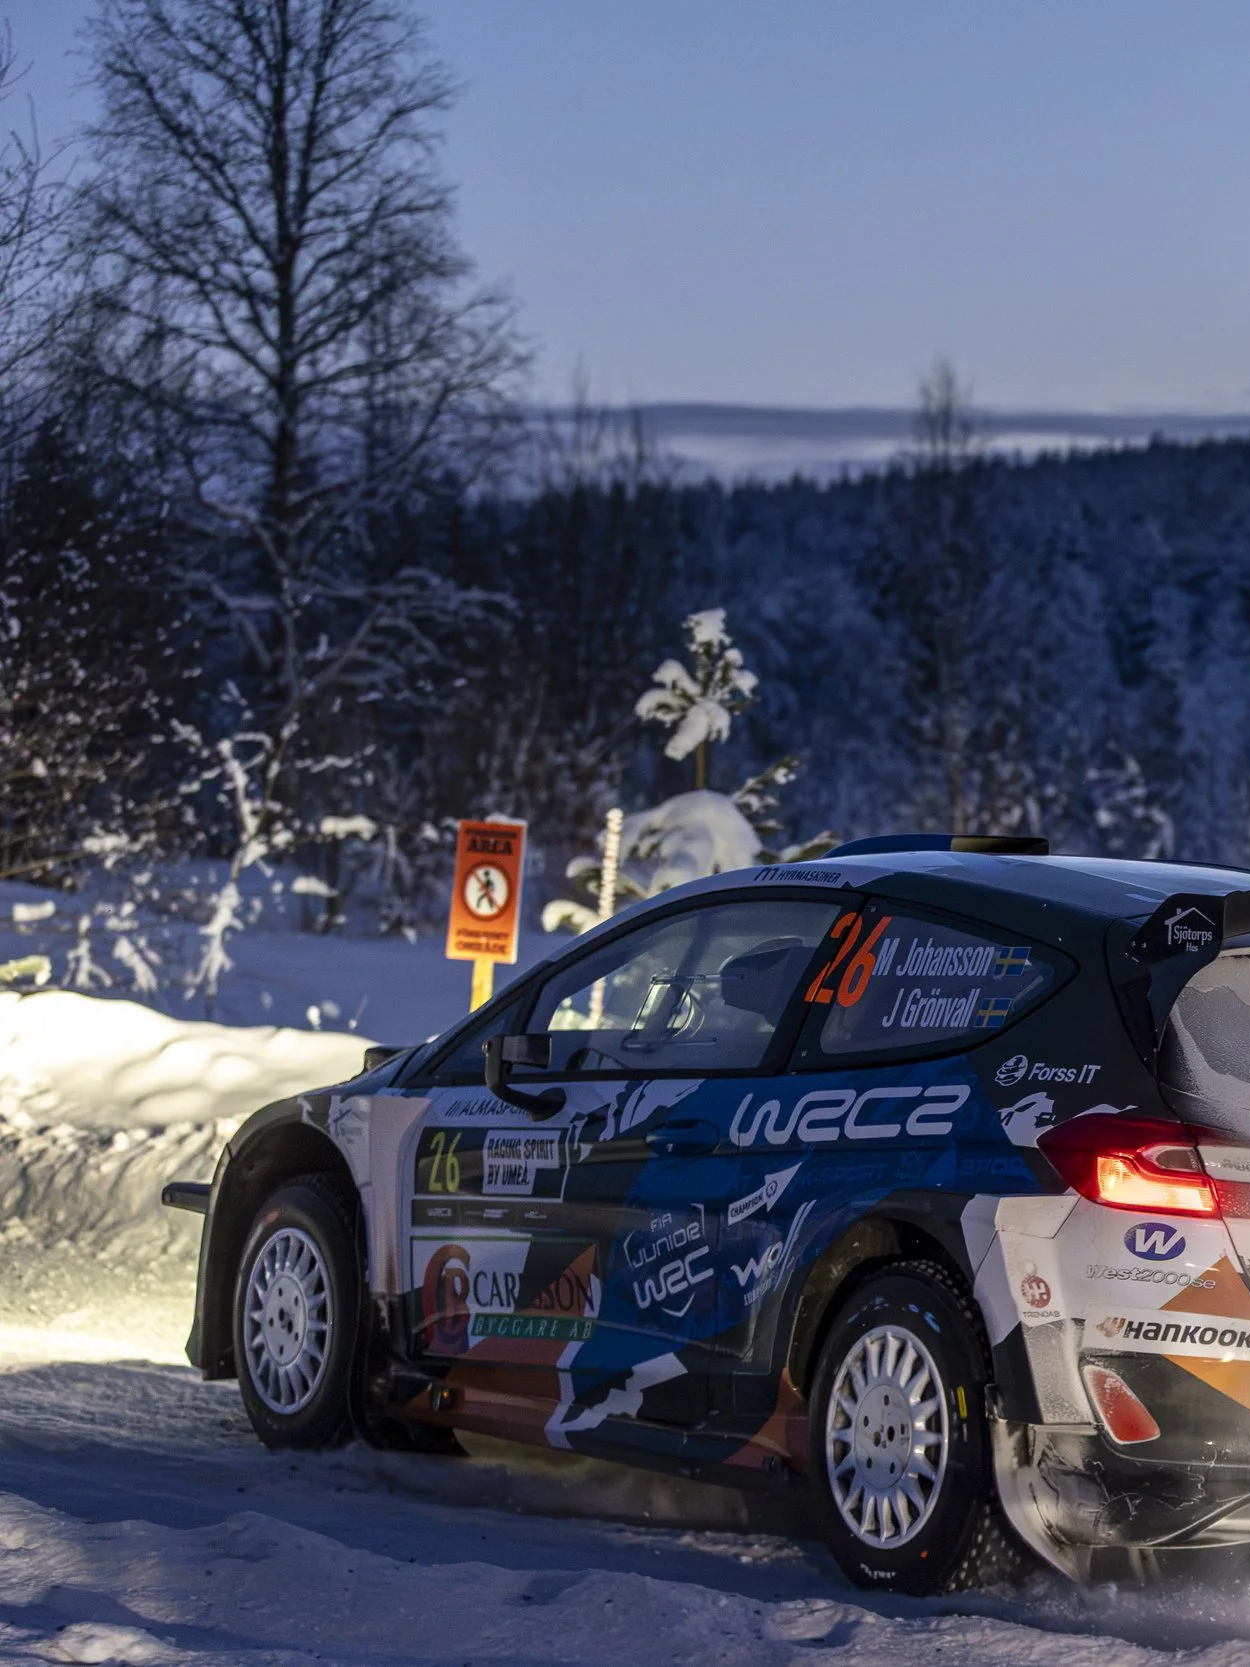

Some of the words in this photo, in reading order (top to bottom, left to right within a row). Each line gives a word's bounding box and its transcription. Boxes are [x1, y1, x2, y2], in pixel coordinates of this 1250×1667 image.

[1173, 925, 1213, 946] Sjötorps
[804, 911, 891, 1007] 26
[871, 938, 900, 976] M
[896, 938, 995, 976] Johansson
[882, 987, 904, 1027] J
[901, 987, 981, 1028] Grönvall
[1028, 1063, 1077, 1082] Forss
[1078, 1065, 1101, 1084] IT
[729, 1084, 971, 1147] WRC2
[429, 1131, 462, 1192] 26
[524, 1139, 555, 1160] SPIRIT
[488, 1162, 501, 1185] BY
[730, 1193, 765, 1218] CHAMPION
[650, 1212, 672, 1233] FIA
[634, 1221, 701, 1269] JUNIOR
[633, 1244, 715, 1309] WRC
[569, 1320, 594, 1339] AB
